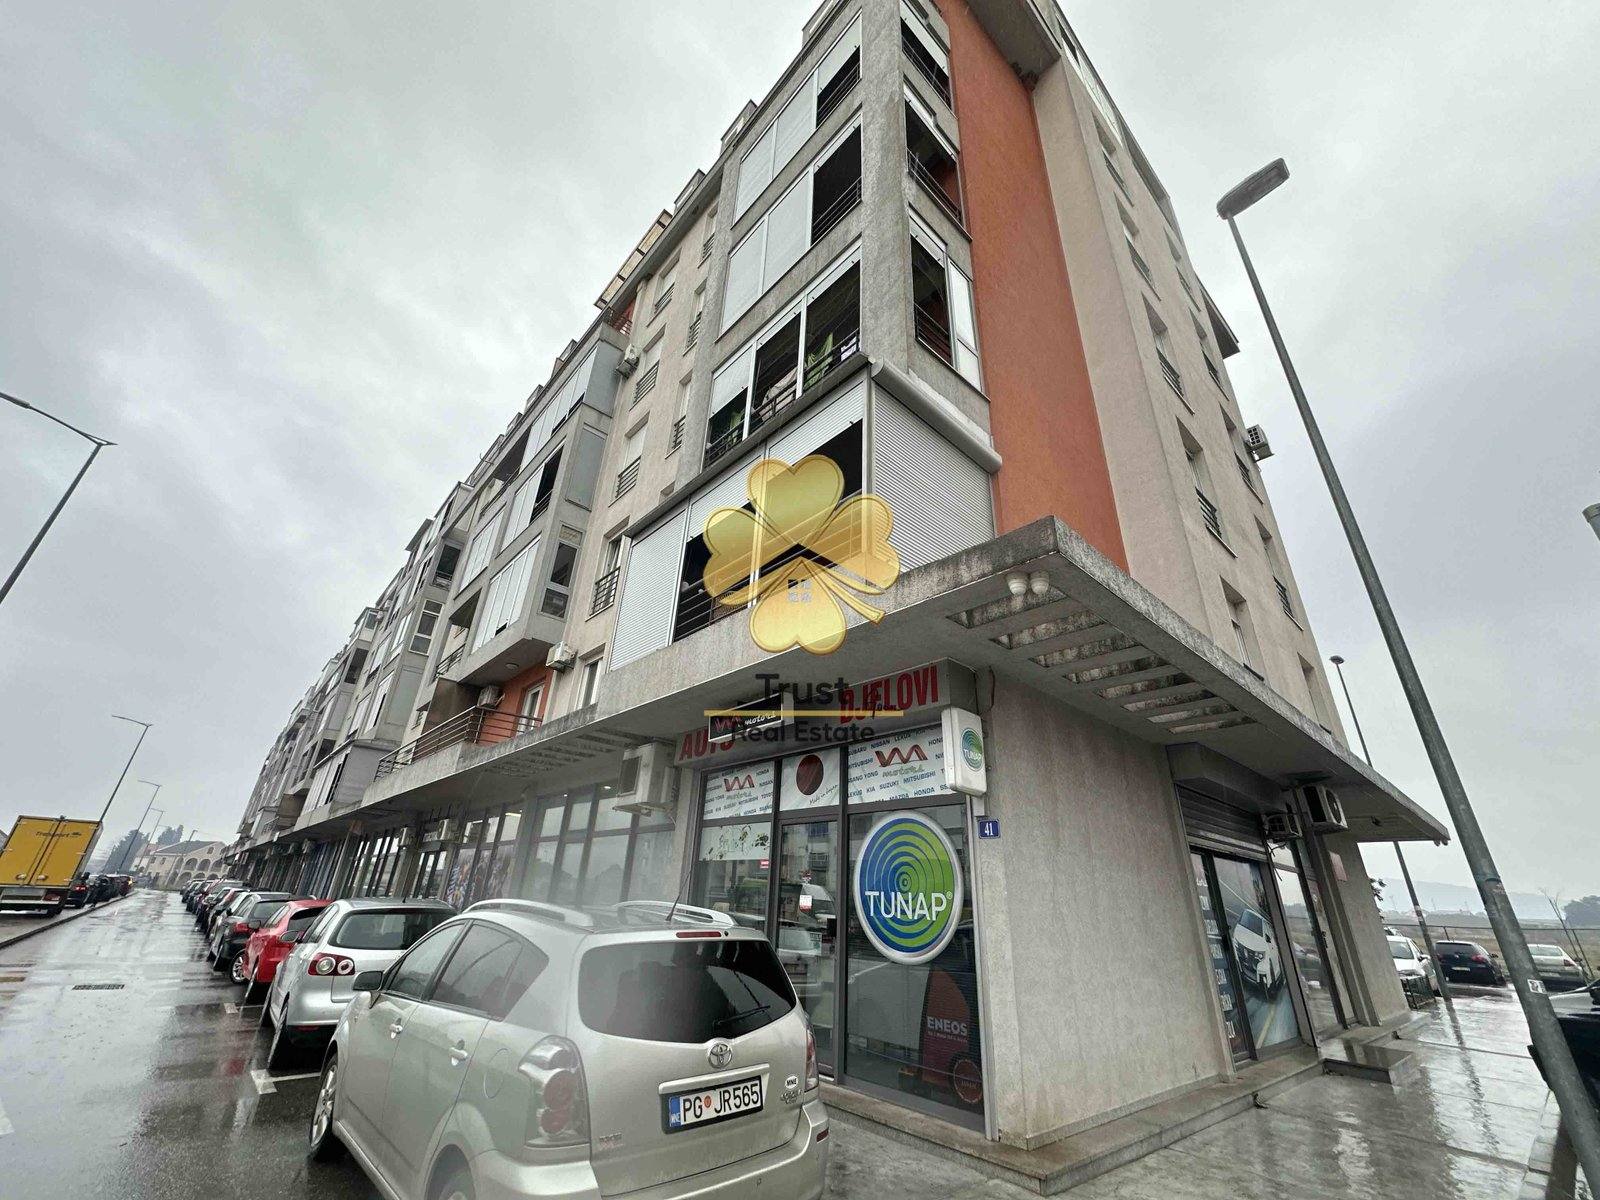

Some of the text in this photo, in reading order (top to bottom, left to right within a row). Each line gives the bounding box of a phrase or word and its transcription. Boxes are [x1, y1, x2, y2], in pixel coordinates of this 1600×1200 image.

[840, 665, 939, 724] DJELOVI
[879, 781, 899, 790] SUZUKI
[903, 770, 936, 784] MITSUBISHI
[914, 786, 935, 797] HONDA
[984, 822, 994, 836] 41
[865, 890, 947, 920] TUNAP
[927, 1015, 968, 1037] ENEOS
[683, 1097, 703, 1122] PG
[714, 1082, 759, 1114] JR565
